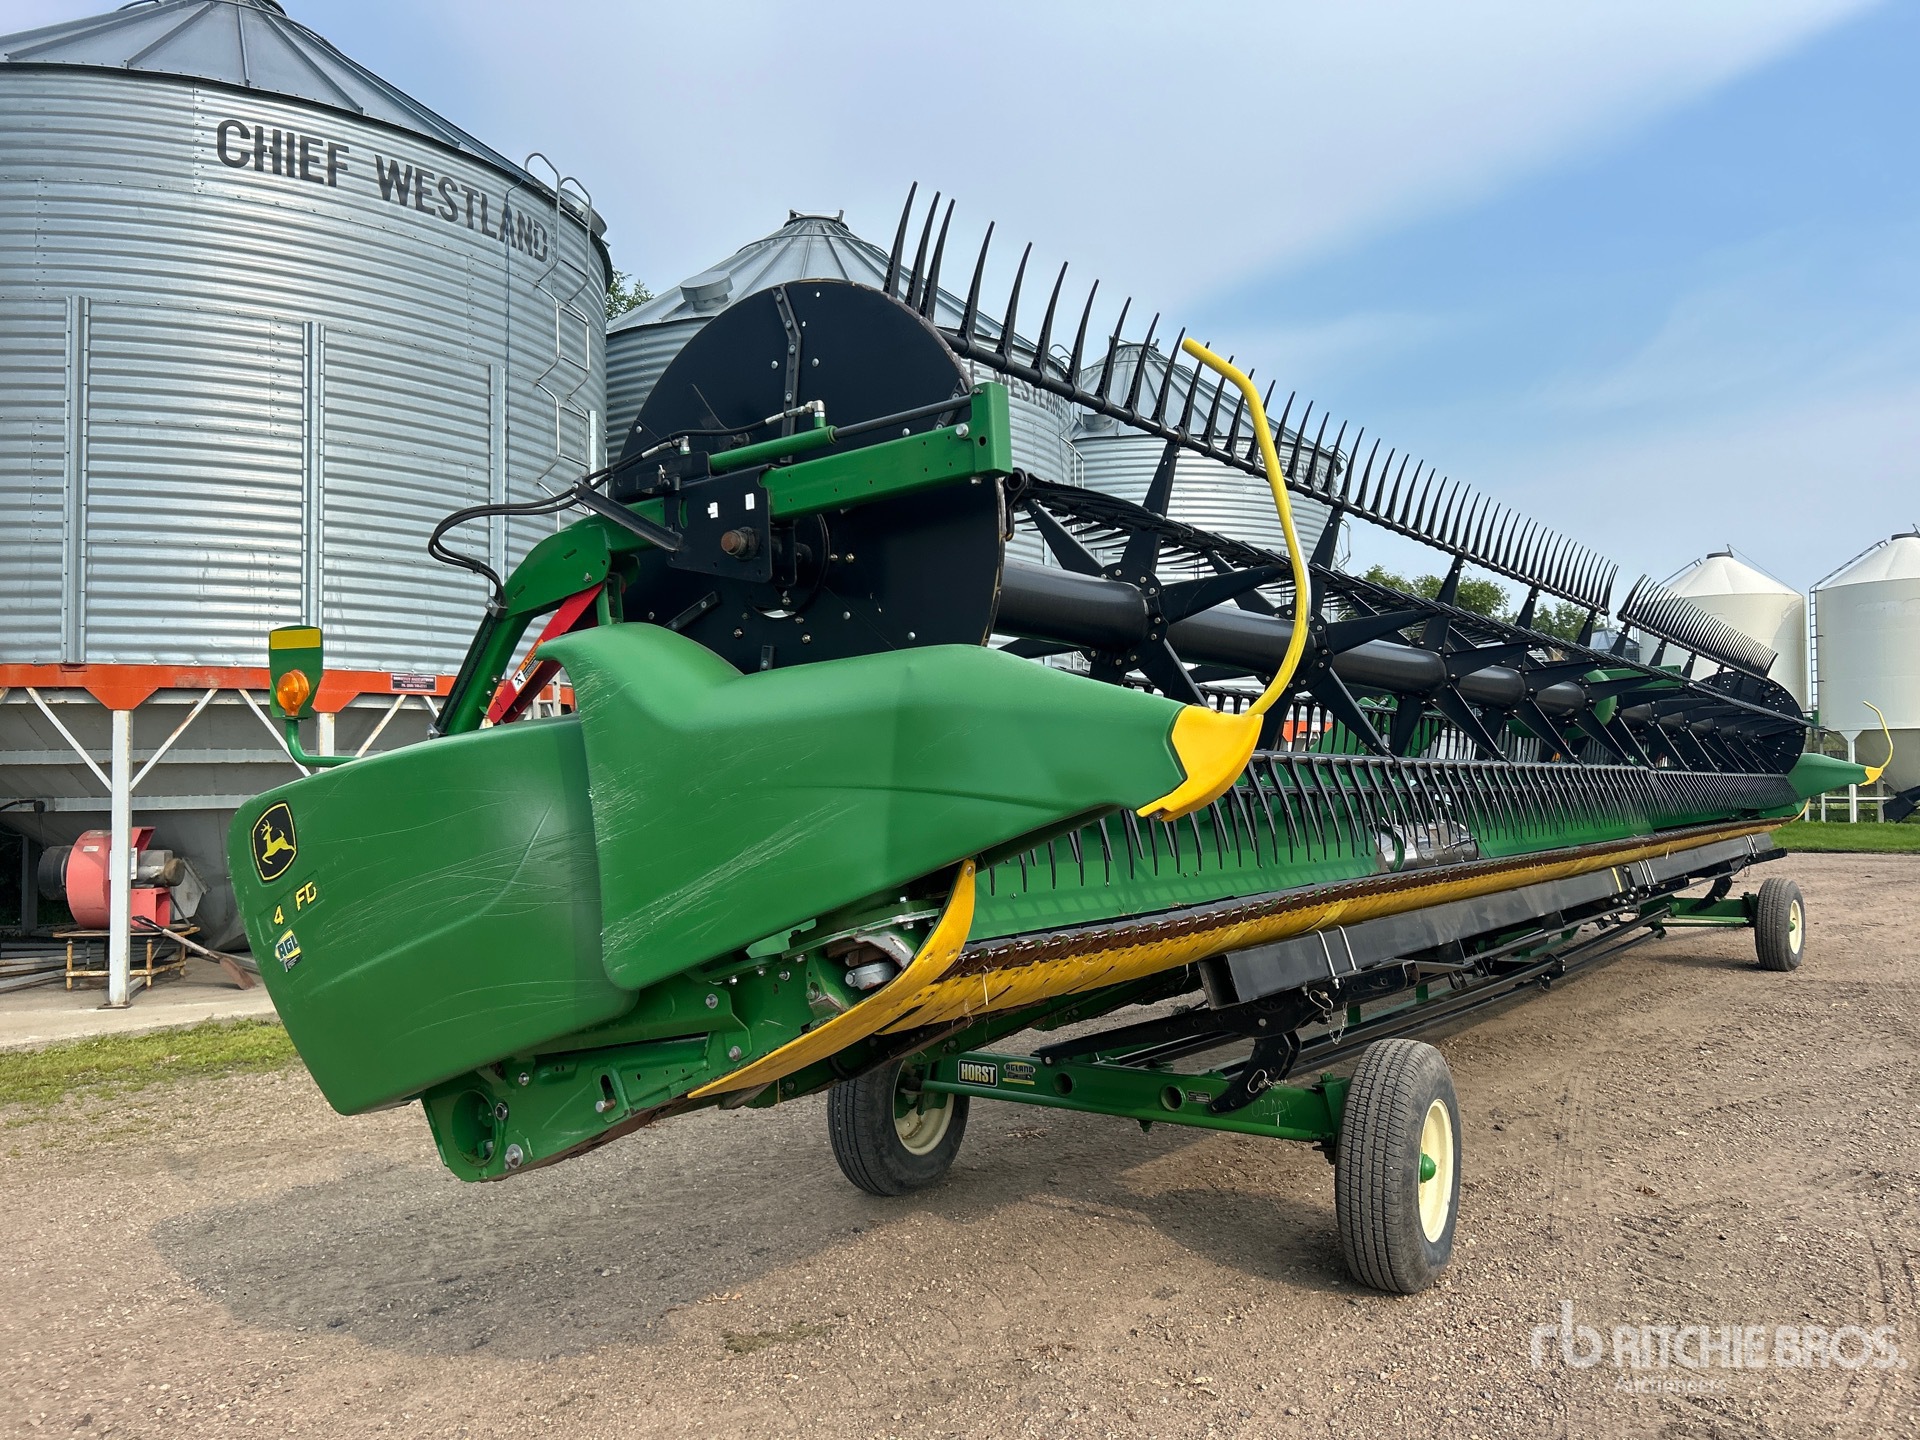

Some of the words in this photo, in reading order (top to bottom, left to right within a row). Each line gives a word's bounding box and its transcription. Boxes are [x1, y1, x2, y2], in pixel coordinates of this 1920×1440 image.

[217, 119, 350, 188] CHIEF
[374, 154, 549, 262] WESTLAND
[960, 1063, 996, 1083] HORST
